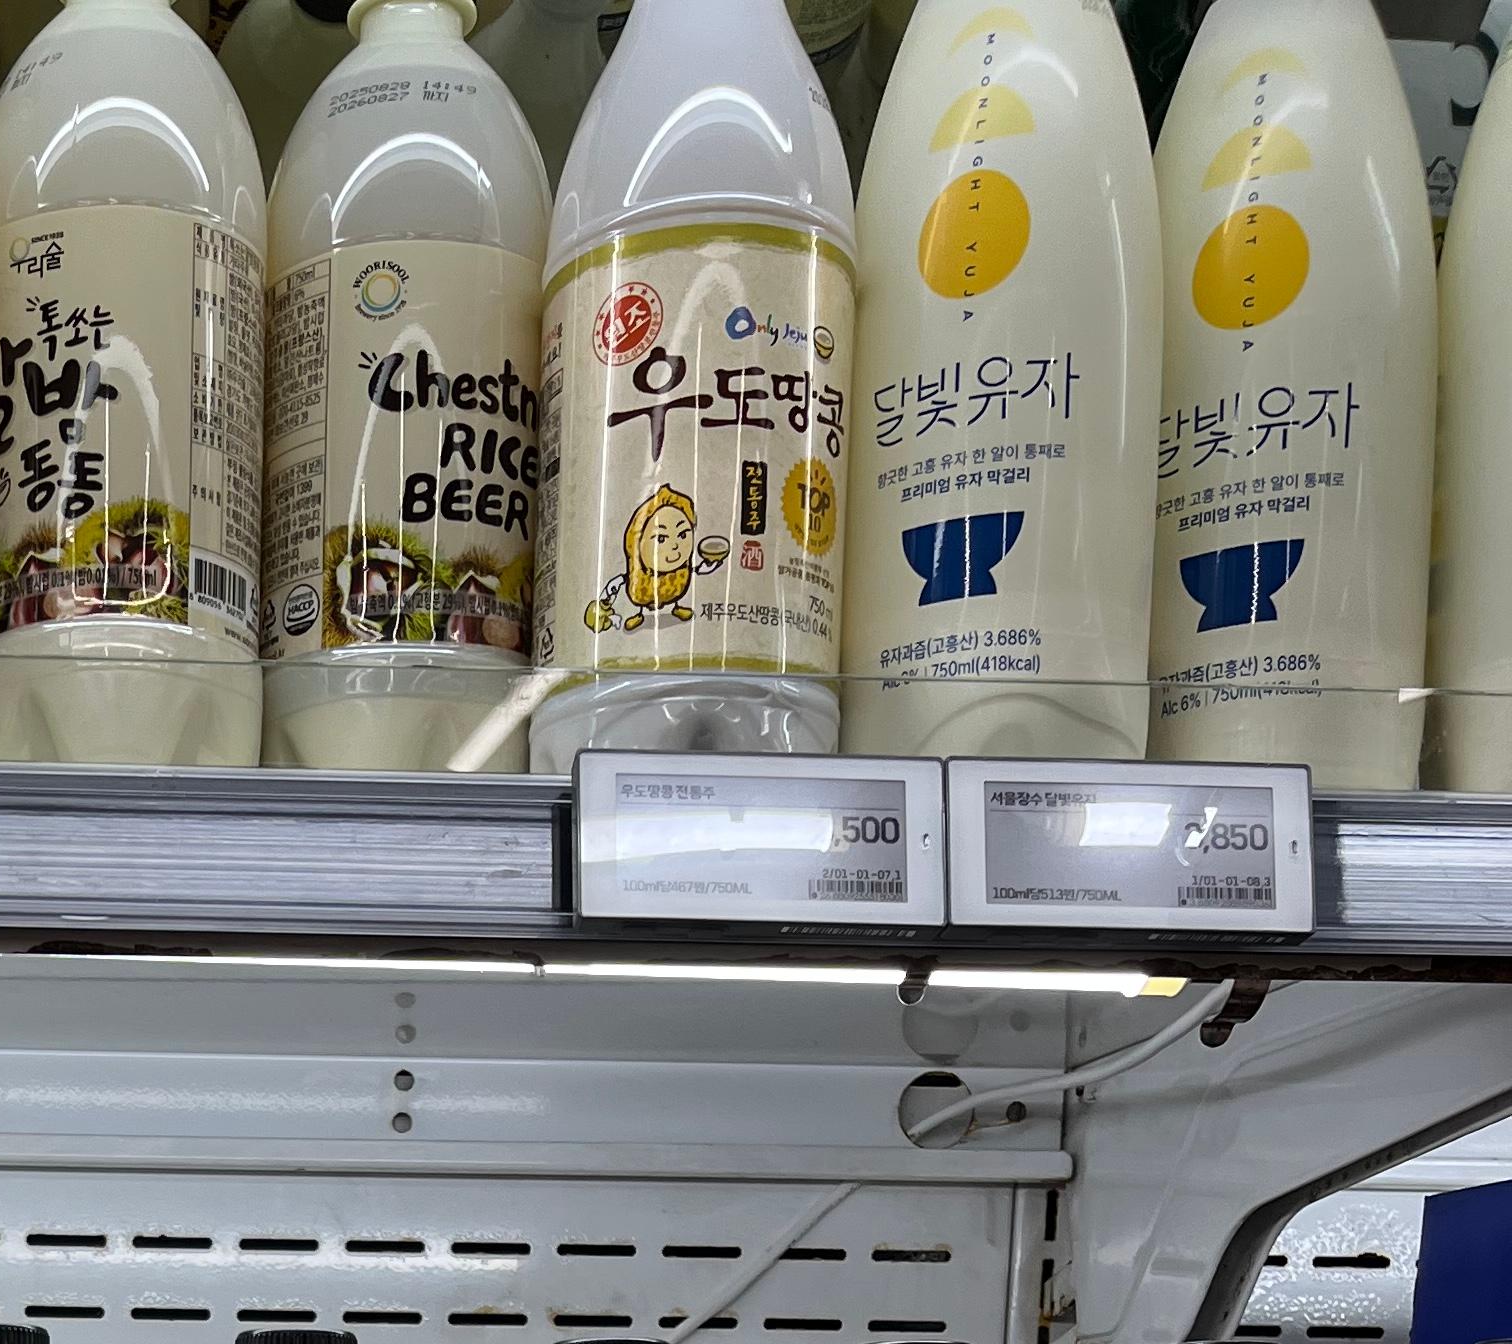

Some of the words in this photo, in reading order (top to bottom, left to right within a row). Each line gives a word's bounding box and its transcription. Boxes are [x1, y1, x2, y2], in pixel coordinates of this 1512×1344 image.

[969, 33, 997, 213] MOONLIGHT
[1244, 73, 1268, 245] MOONLIGHT
[353, 260, 410, 290] WOORISOOL
[962, 242, 979, 322] YUJA
[725, 306, 778, 346] Only
[1241, 273, 1257, 353] YUJA
[607, 347, 844, 462] 우도땅콩
[873, 352, 1080, 449] 달빛유자
[941, 452, 967, 470] 유자
[972, 448, 986, 464] 한
[991, 445, 1019, 462] 알이
[401, 472, 531, 541] BEER
[901, 479, 950, 503] 프리미엄
[955, 472, 982, 491] 유자
[987, 467, 1030, 484] 막걸리
[880, 631, 979, 668] 유자과즙(고흥산)
[983, 629, 1041, 647] 3.686%
[931, 655, 1041, 678] 750ml(418kcal)
[1161, 700, 1178, 718] Alc
[1181, 693, 1201, 710] 6%
